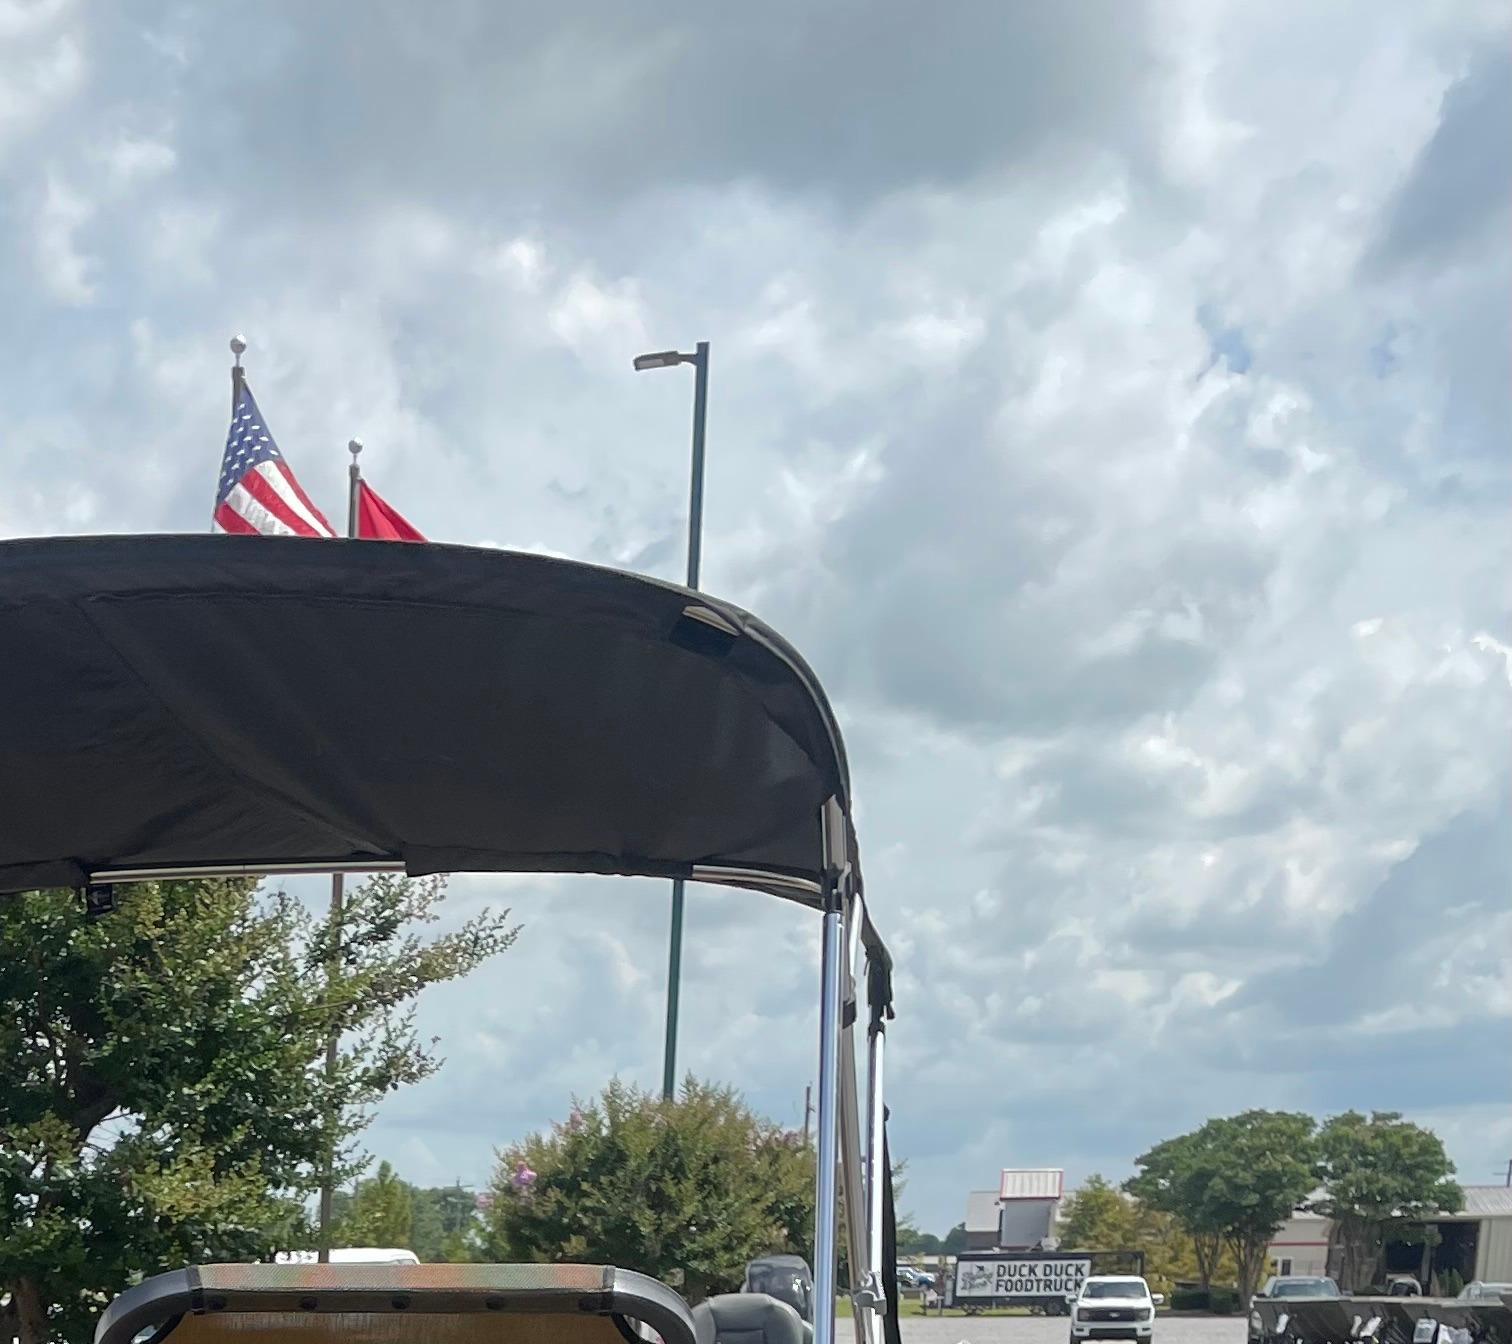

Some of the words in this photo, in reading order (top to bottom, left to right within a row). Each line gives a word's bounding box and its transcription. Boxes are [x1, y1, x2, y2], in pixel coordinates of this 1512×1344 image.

[996, 1264, 1038, 1277] DUCK
[1043, 1263, 1086, 1277] DUCK
[995, 1278, 1084, 1293] FOODTRUCK
